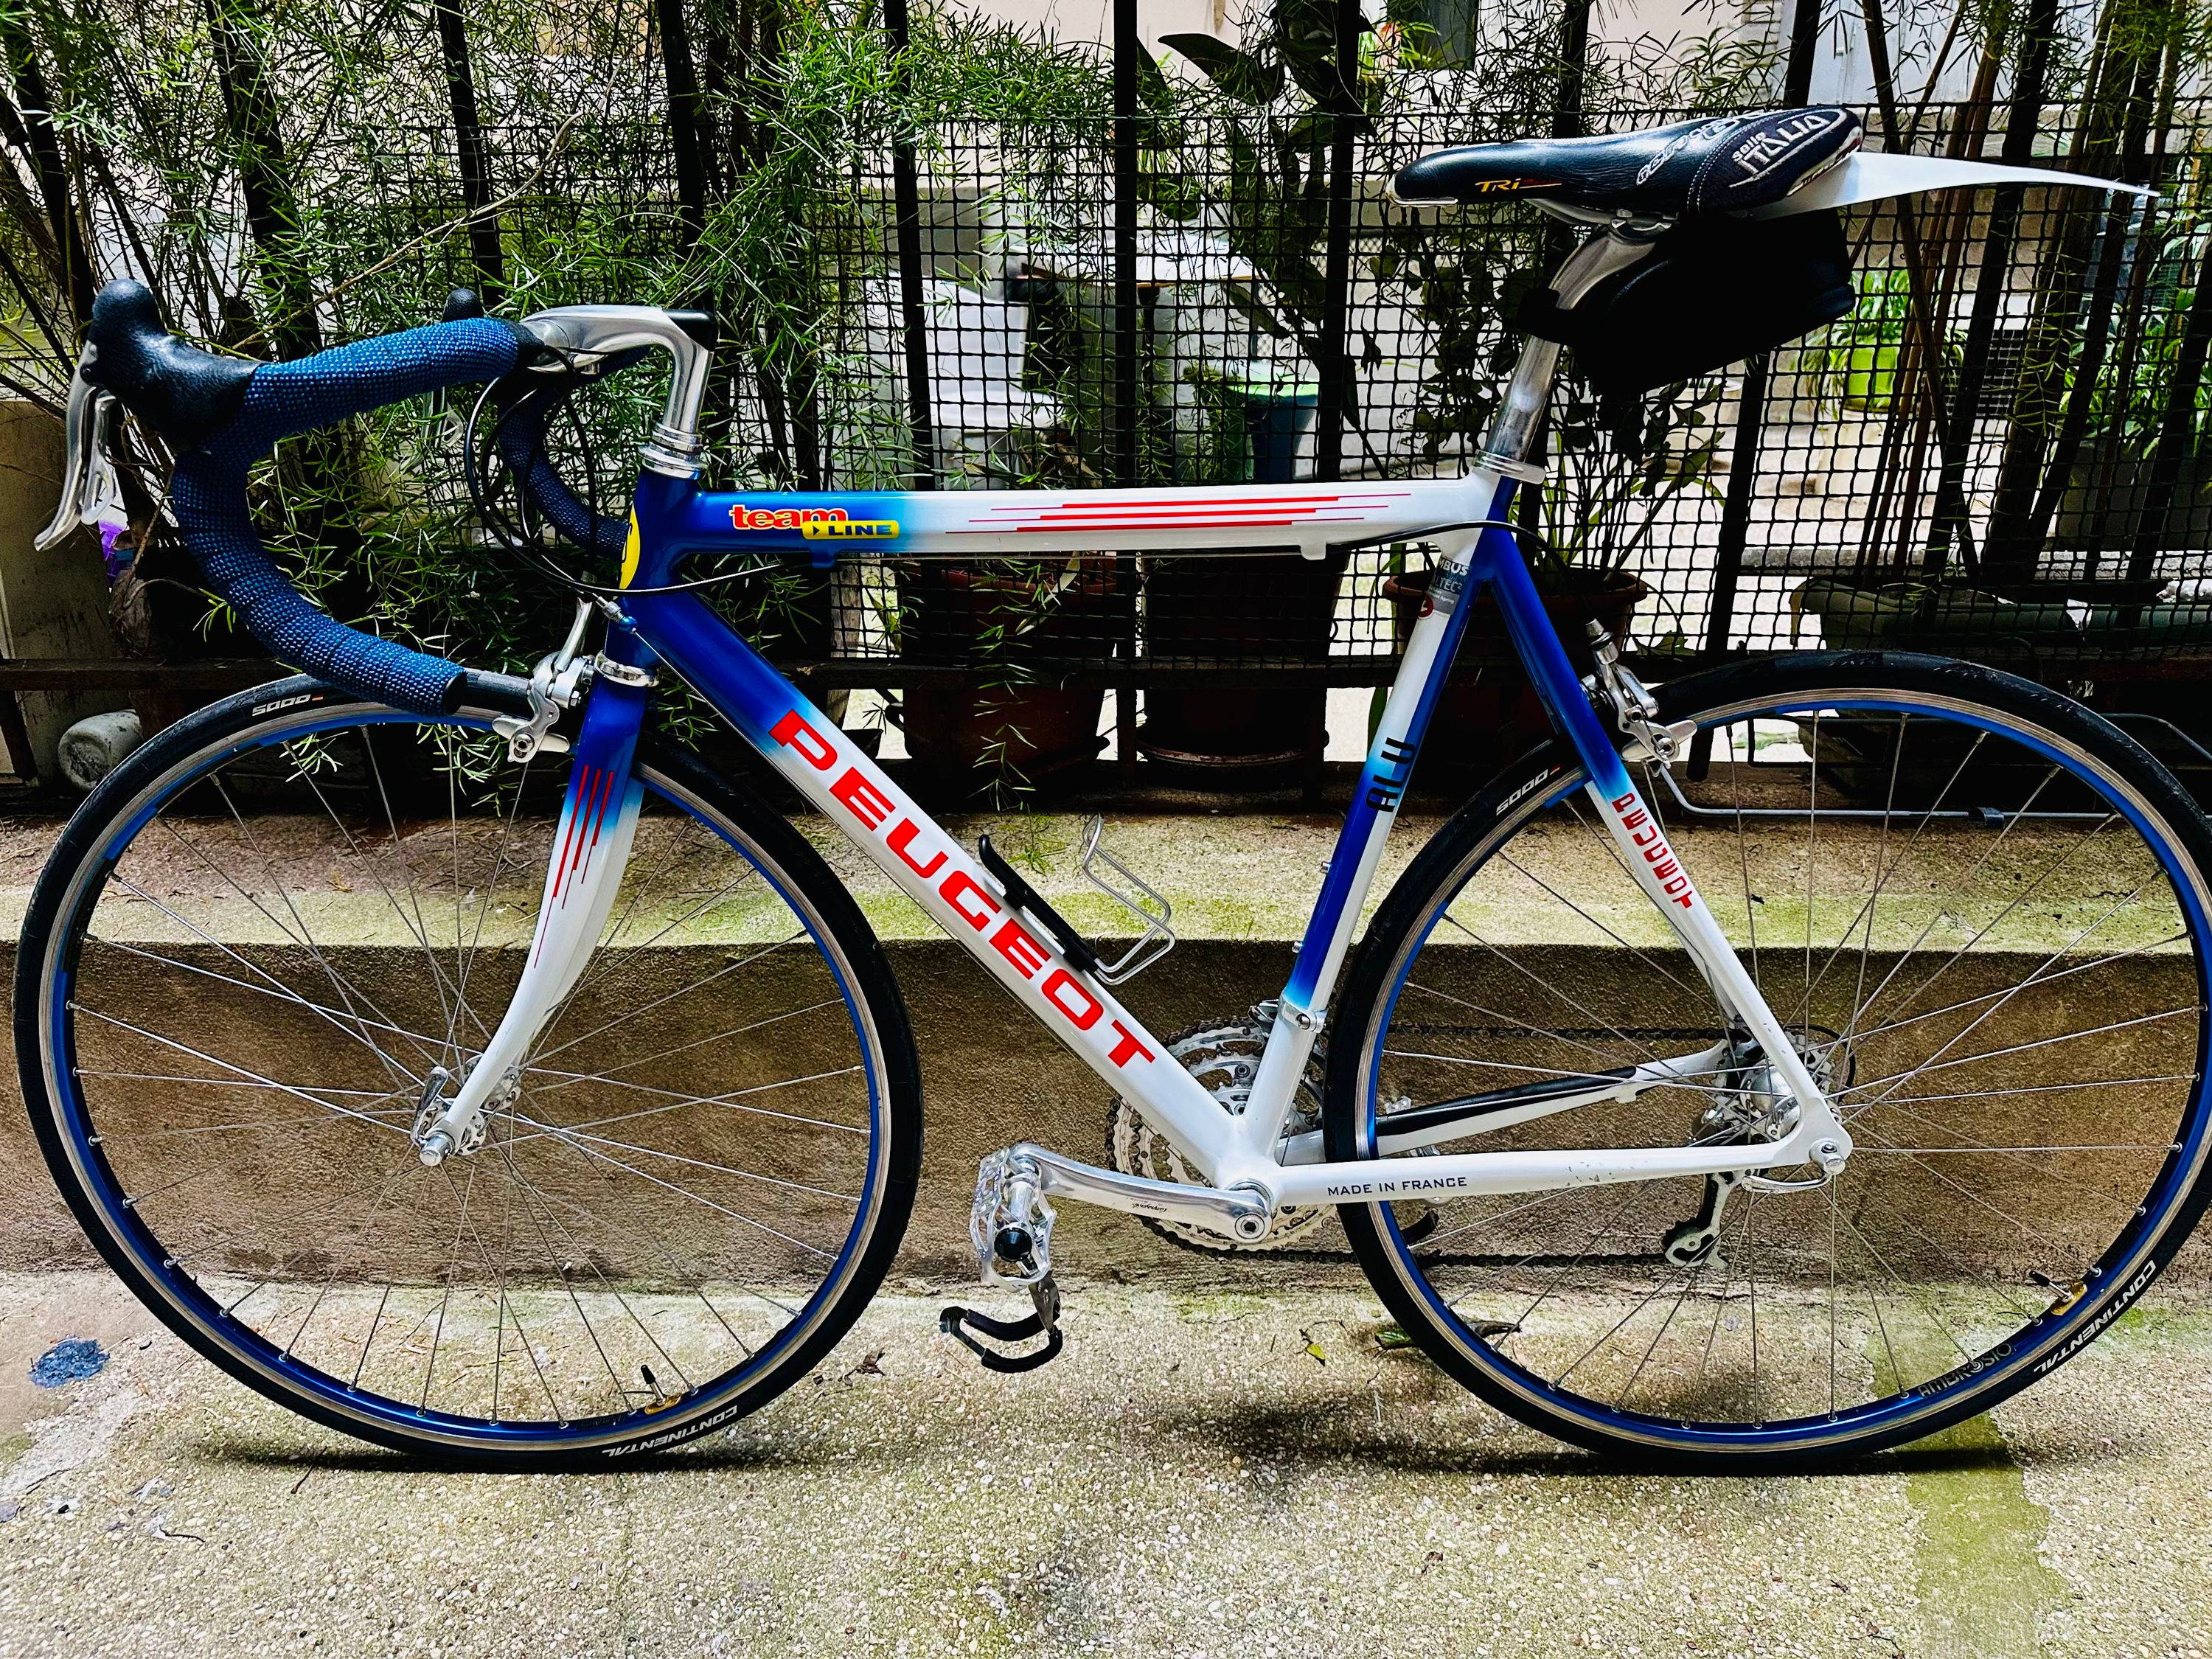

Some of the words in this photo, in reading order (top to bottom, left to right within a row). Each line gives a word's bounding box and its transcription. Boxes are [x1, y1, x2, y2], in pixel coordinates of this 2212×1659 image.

[1737, 114, 1832, 176] ITALIA
[729, 504, 848, 529] team
[828, 524, 893, 536] LINE
[251, 694, 311, 717] 5000
[1366, 737, 1416, 813] ALU
[1496, 768, 1548, 816] 5000
[1612, 792, 1693, 909] PEUGEOT
[768, 709, 1156, 1068] PEUGEOT
[1327, 1183, 1373, 1197] MADE
[1379, 1182, 1396, 1192] IN
[1402, 1177, 1467, 1191] FRANCE
[2033, 1259, 2157, 1373] CONTINENTAL
[1917, 1343, 2012, 1397] AMBROSIO
[602, 1405, 737, 1457] CONTINENTAL
